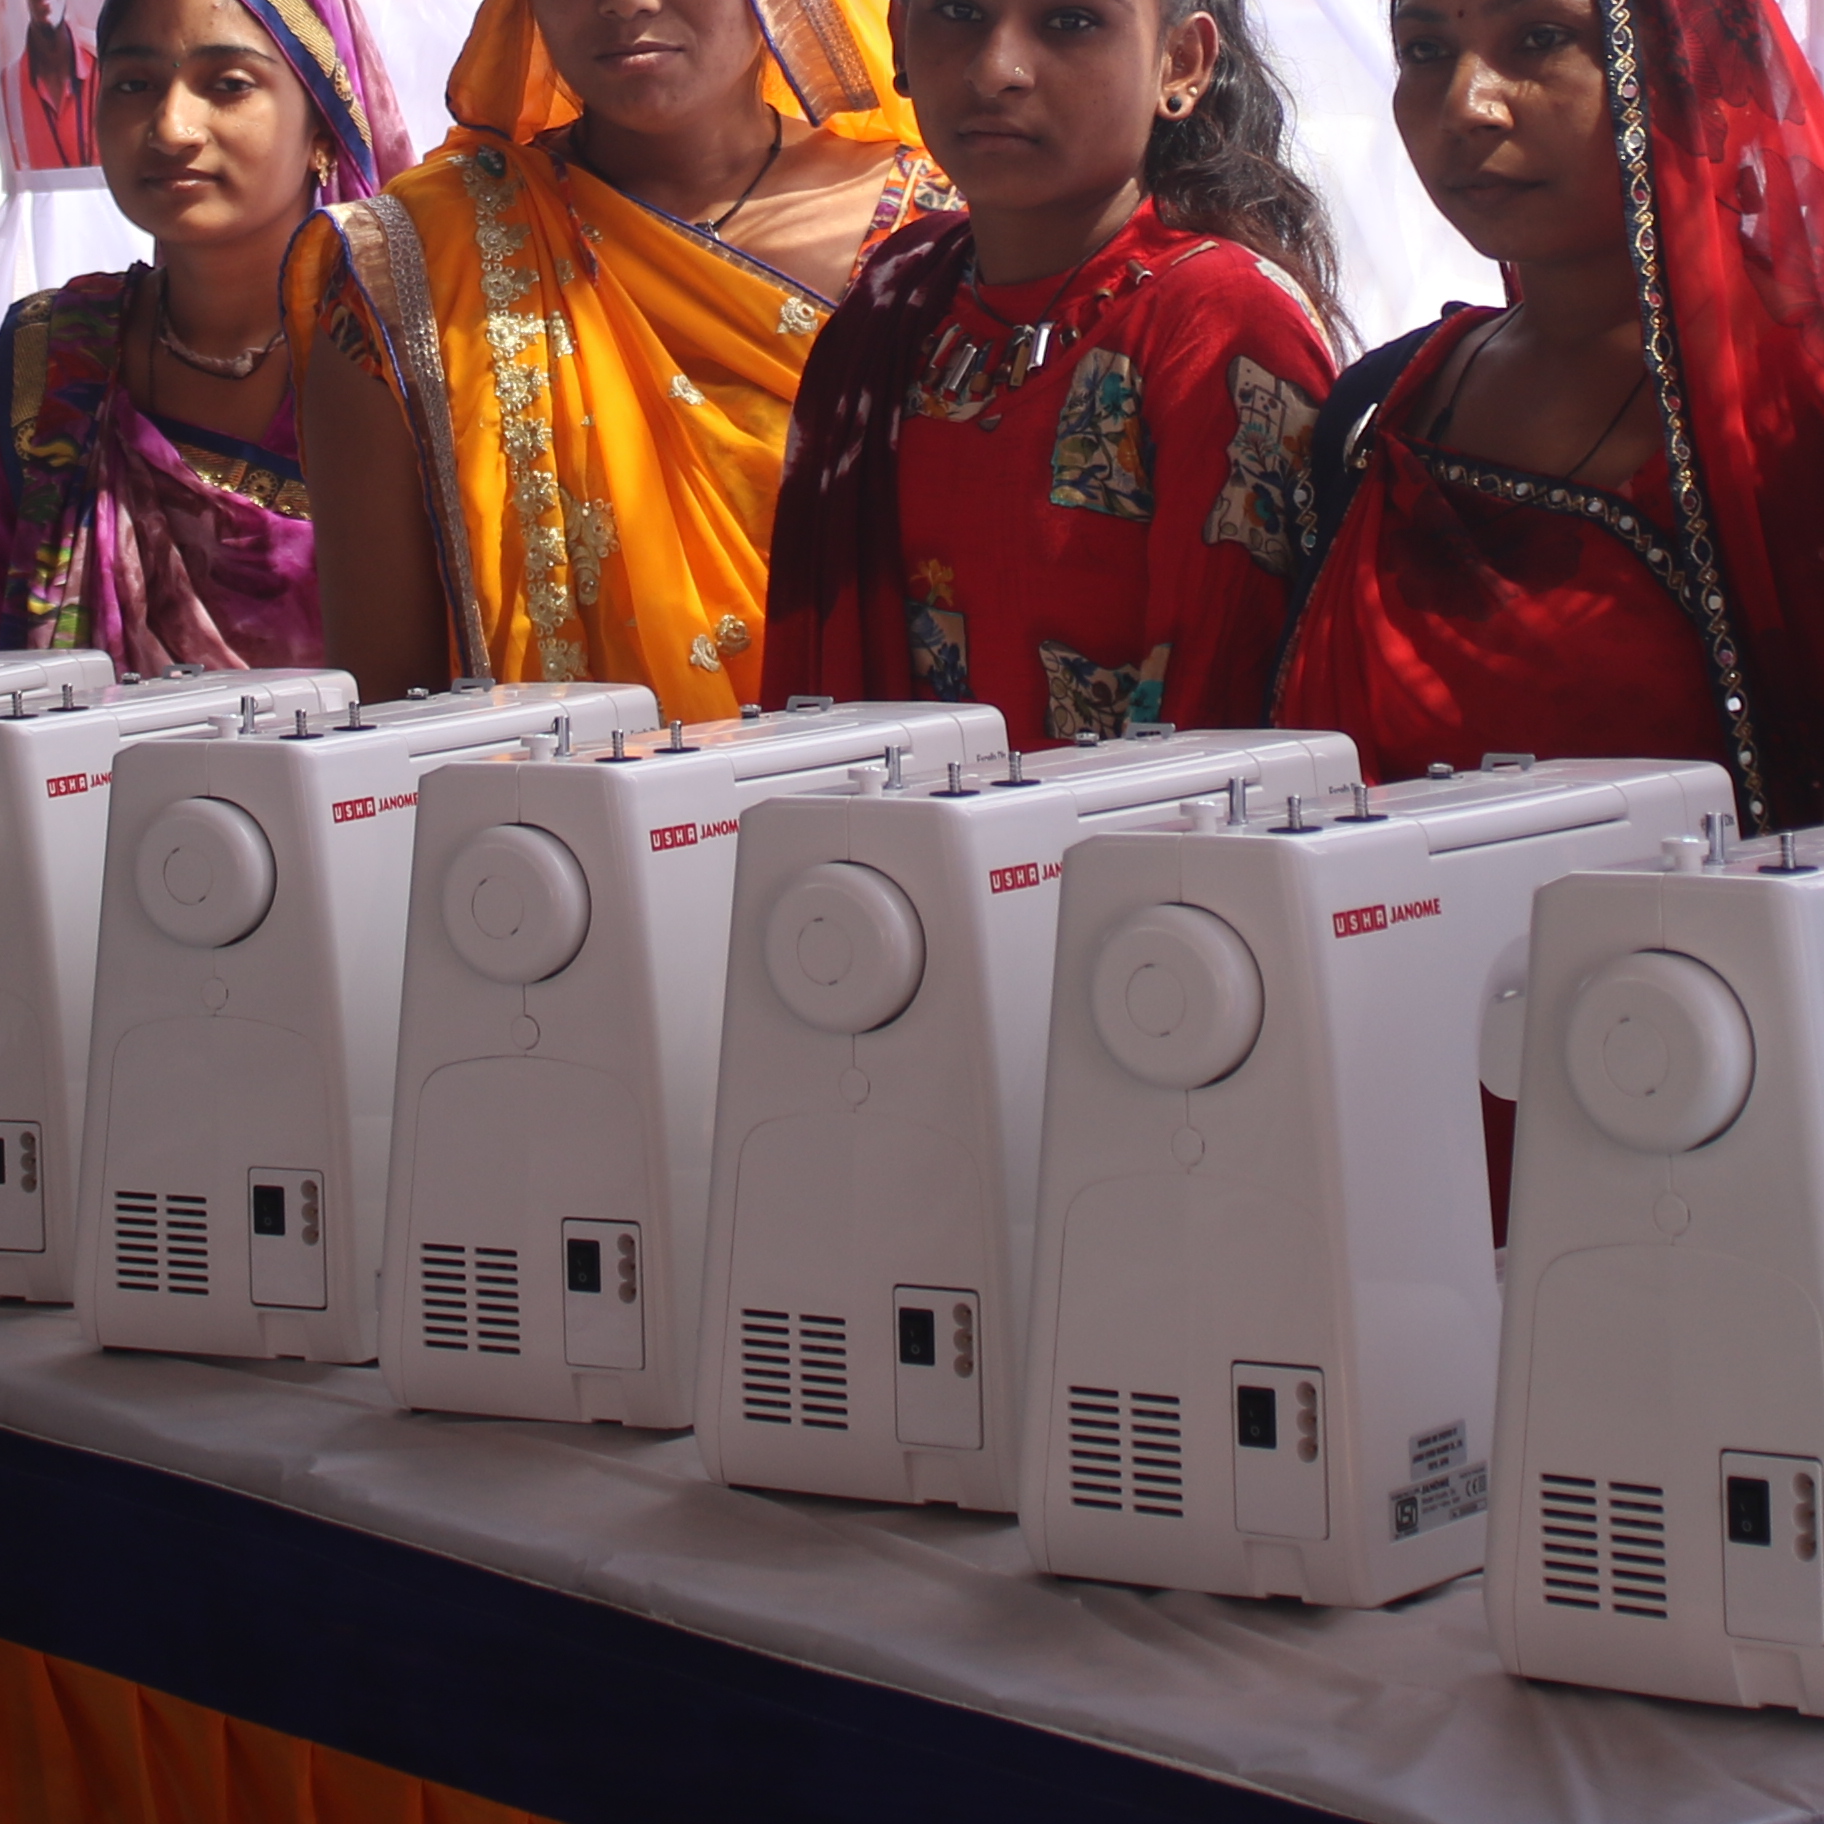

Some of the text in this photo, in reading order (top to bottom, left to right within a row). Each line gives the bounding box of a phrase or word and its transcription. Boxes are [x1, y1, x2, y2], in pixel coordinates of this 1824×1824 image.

[47, 771, 113, 797] USHA JANO
[333, 798, 375, 822] USHA
[651, 817, 740, 850] USHA JANOM
[990, 860, 1063, 892] USHA JAN
[1334, 897, 1442, 937] USHA JANOME
